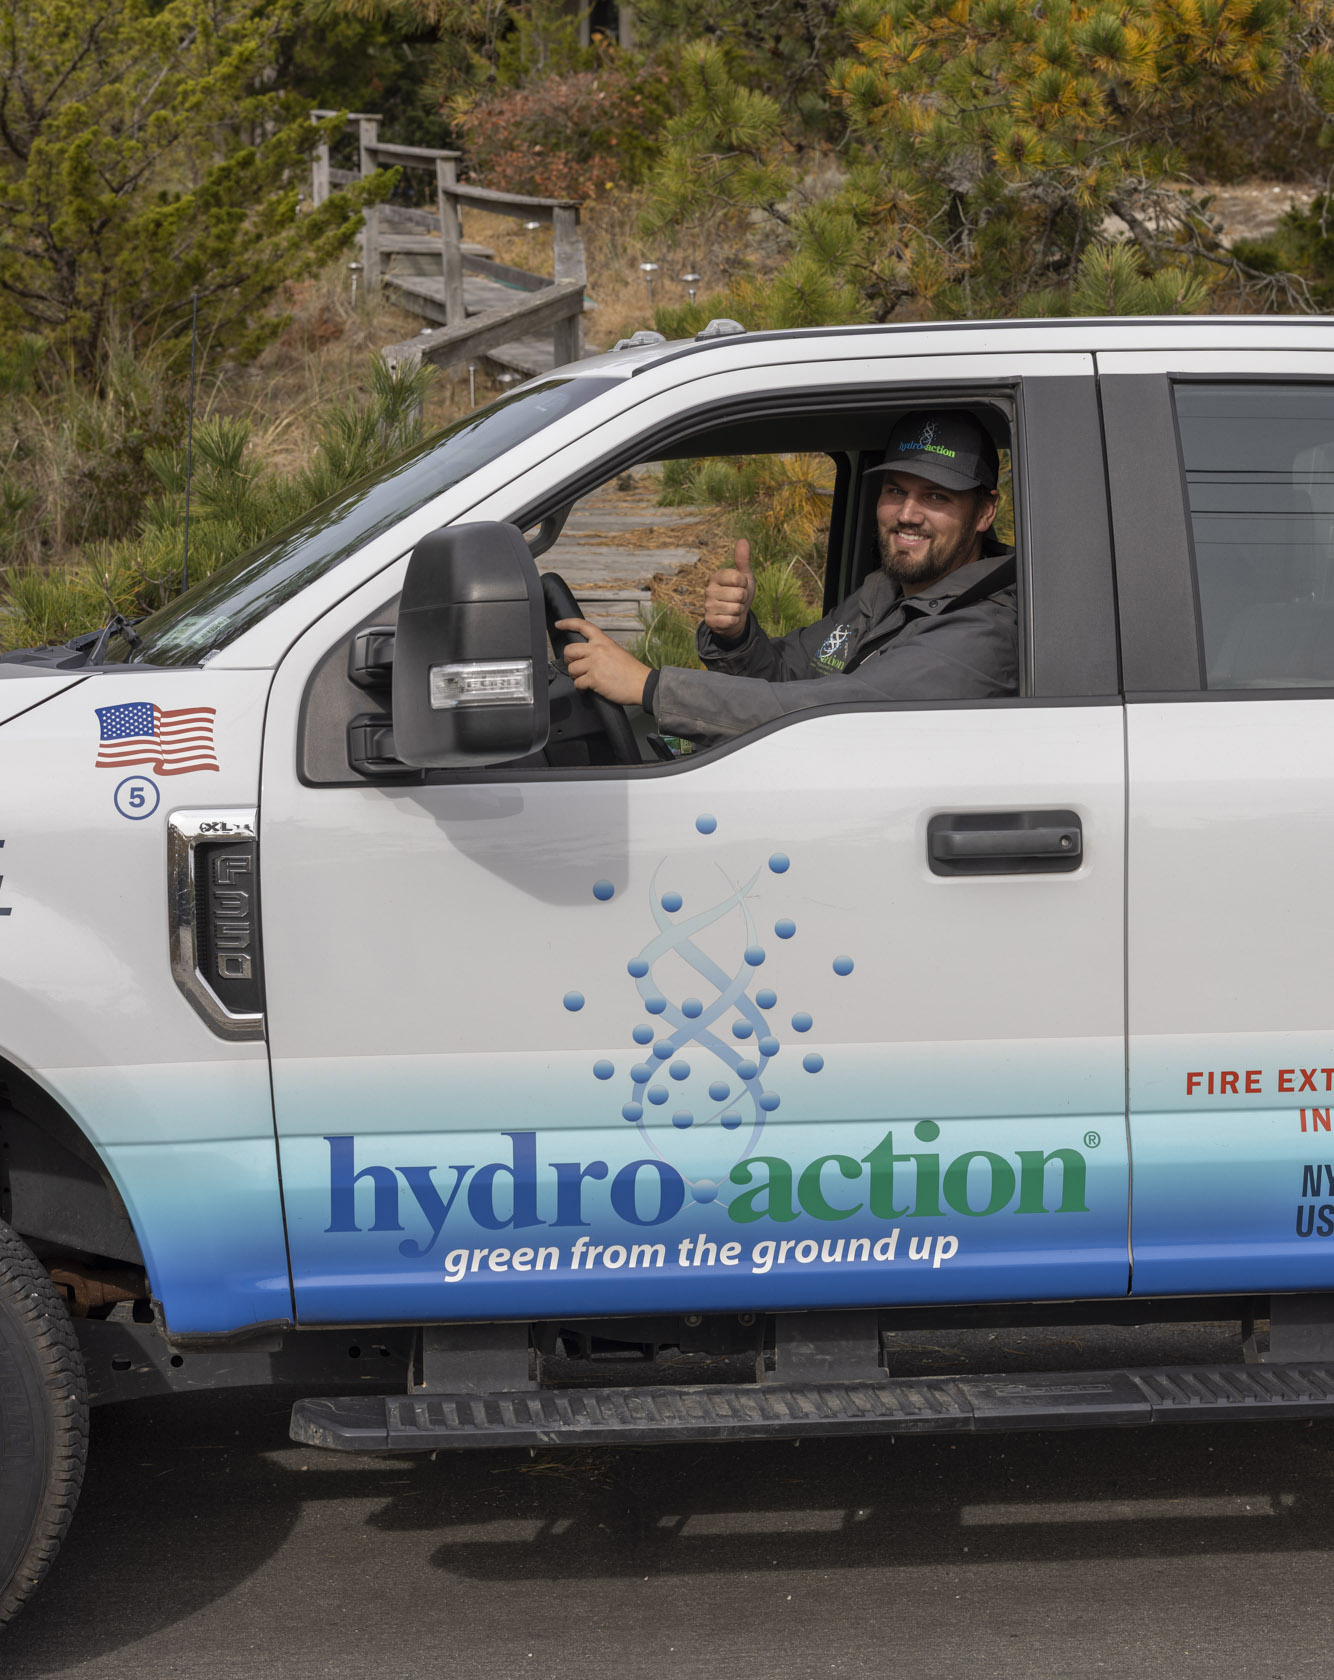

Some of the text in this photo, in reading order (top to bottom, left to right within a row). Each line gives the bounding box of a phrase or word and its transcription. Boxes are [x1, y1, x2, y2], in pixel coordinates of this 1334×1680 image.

[128, 787, 146, 808] 5
[1186, 1067, 1334, 1095] FIRE EXT
[1300, 1107, 1333, 1133] IN
[323, 1131, 685, 1258] hydro
[1296, 1204, 1334, 1238] US
[444, 1228, 959, 1283] green from the ground up
